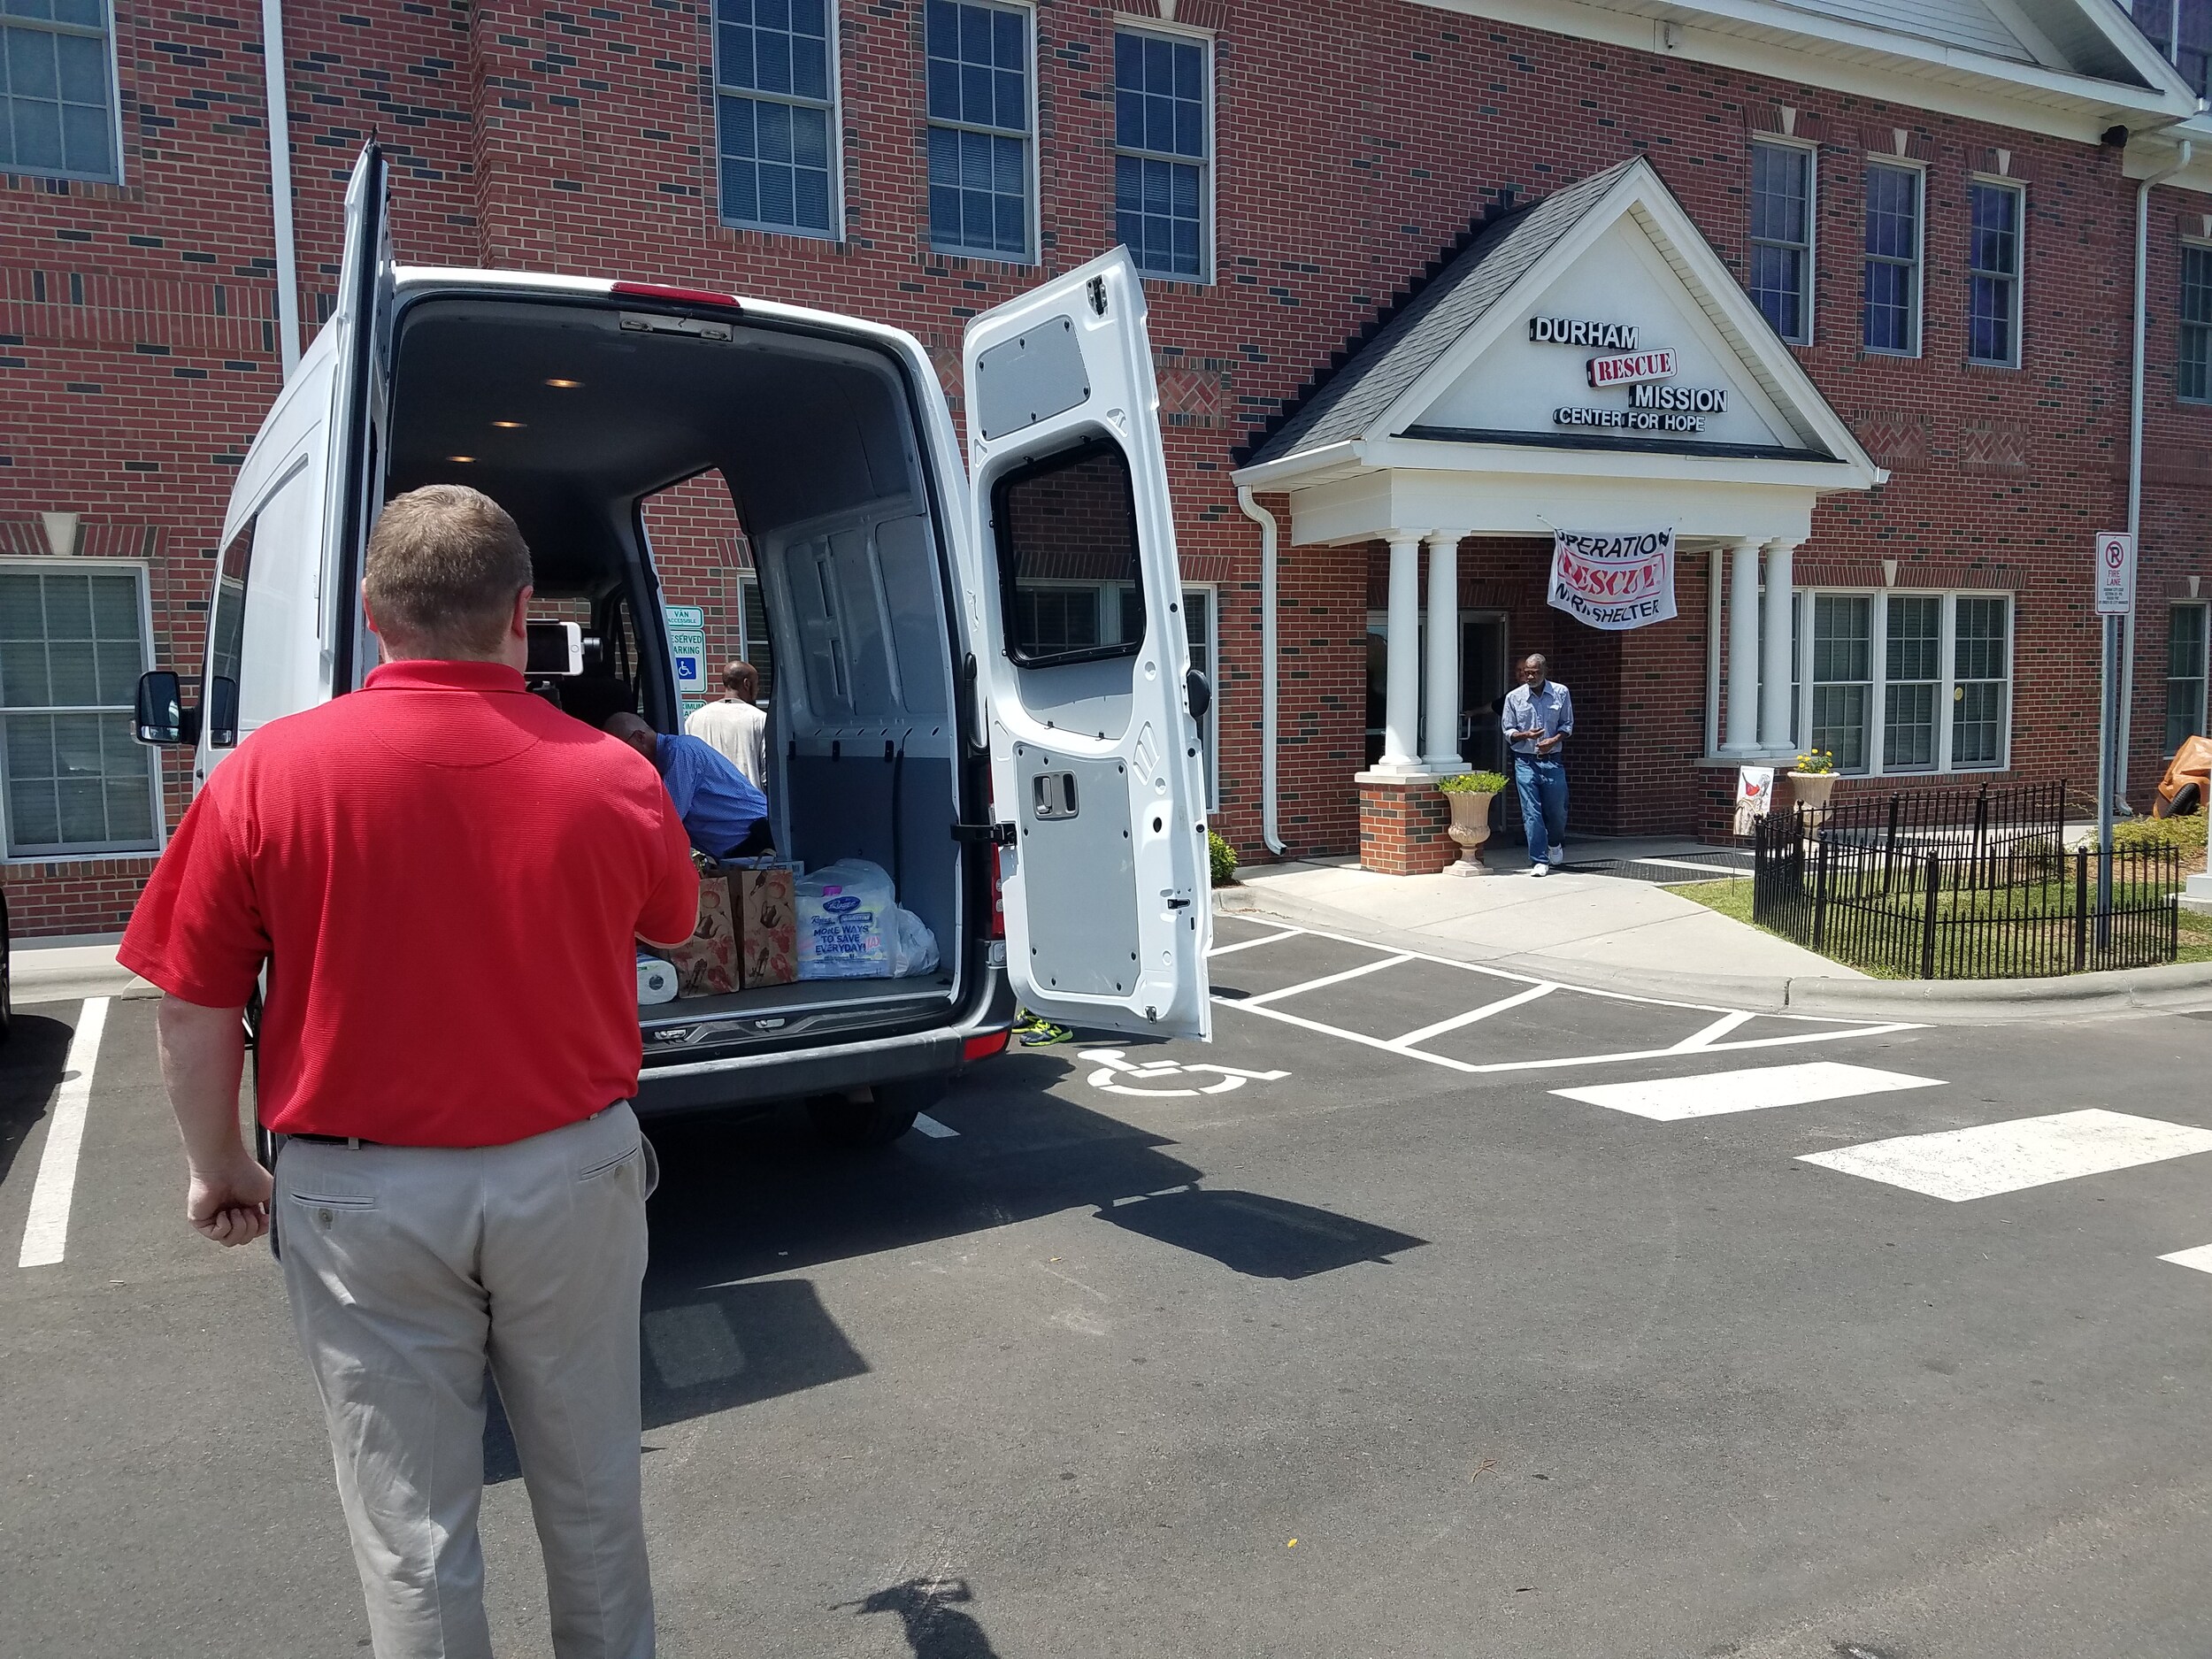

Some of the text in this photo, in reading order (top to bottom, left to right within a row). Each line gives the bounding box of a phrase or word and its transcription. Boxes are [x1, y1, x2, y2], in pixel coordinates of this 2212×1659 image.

[1534, 316, 1640, 349] DURHAM
[1598, 352, 1671, 381] RESCUE
[1635, 385, 1728, 412] MISSION
[1558, 407, 1706, 432] CENTER FOR HOPE
[1591, 599, 1660, 623] SHELTER
[671, 634, 703, 644] ESERVED
[673, 646, 700, 655] ARKING
[814, 925, 869, 937] MORE WAYS
[836, 934, 860, 943] SAVE
